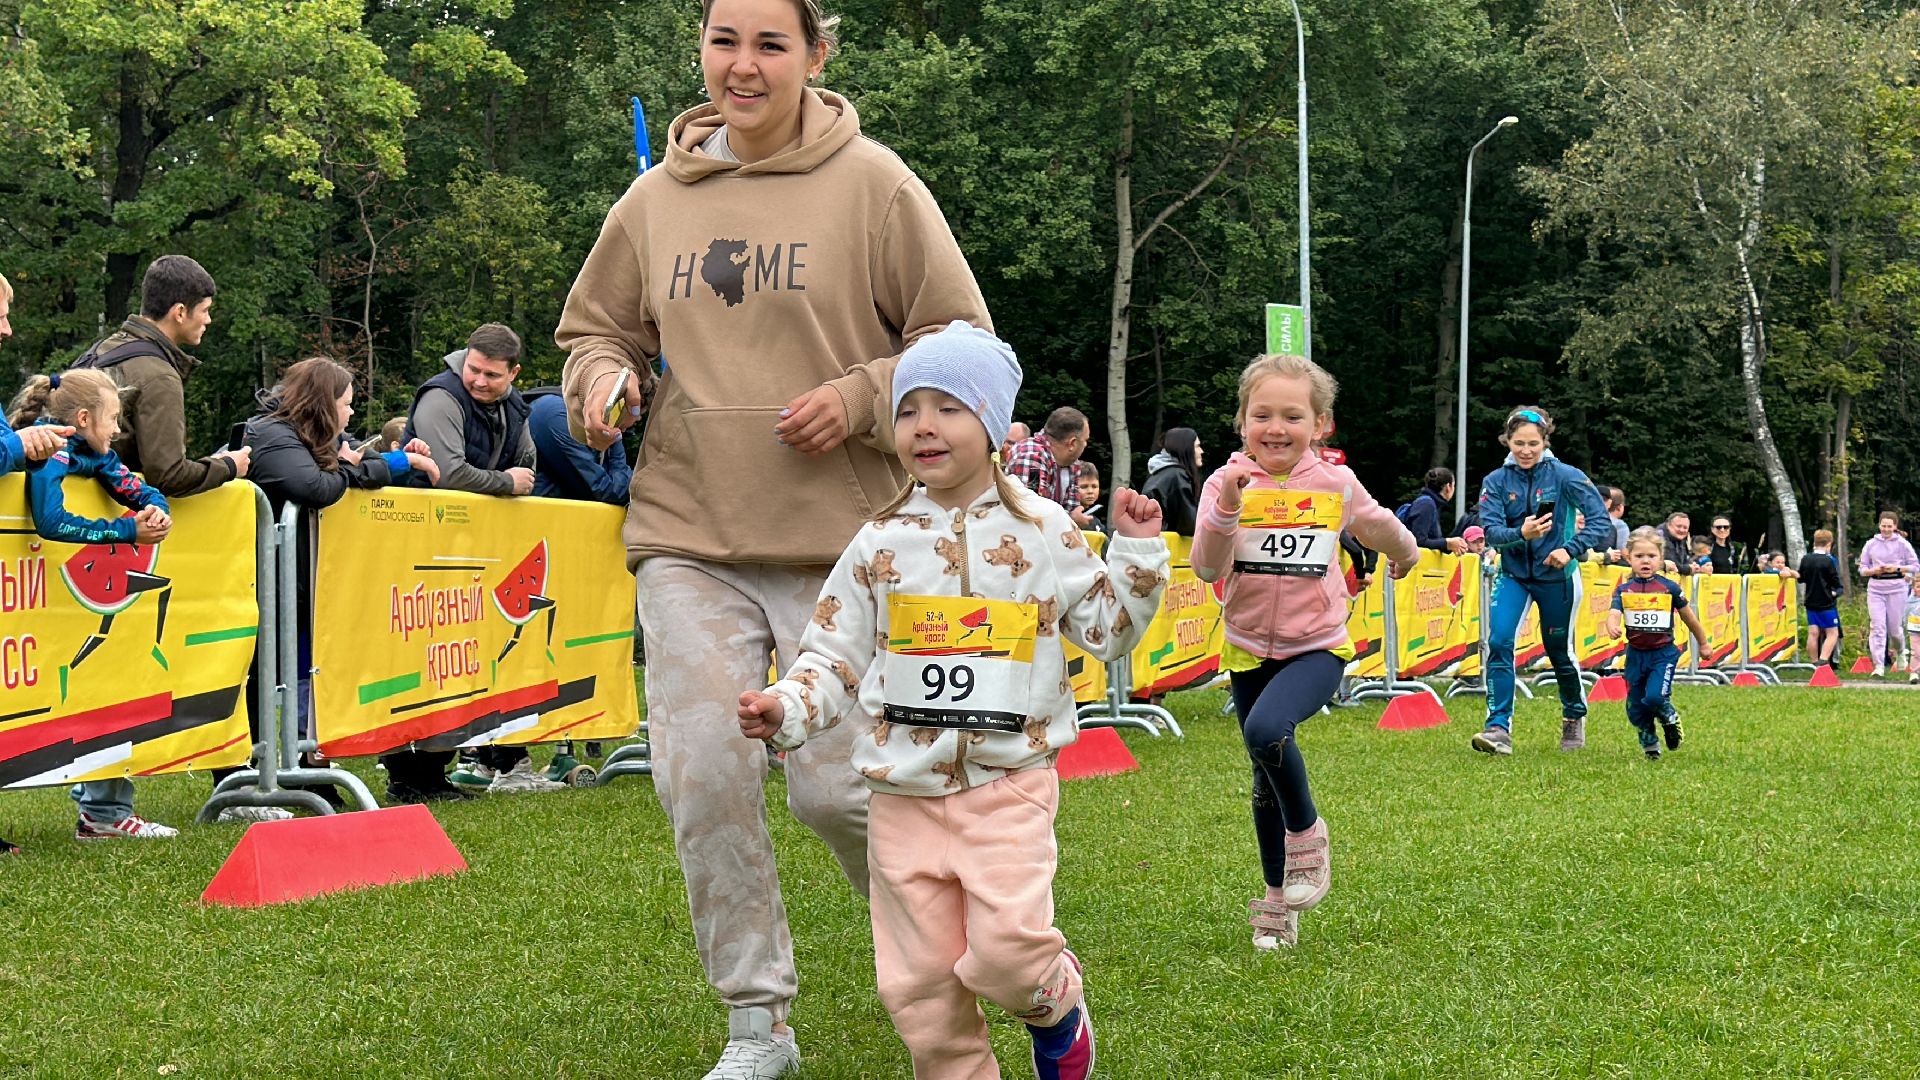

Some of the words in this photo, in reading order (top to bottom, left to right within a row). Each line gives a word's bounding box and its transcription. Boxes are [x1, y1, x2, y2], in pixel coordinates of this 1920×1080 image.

[1280, 313, 1292, 352] СИЛЫ
[372, 499, 395, 509] ПАРКИ
[372, 511, 425, 523] ПОДМОСКОВЬЯ
[1260, 534, 1316, 559] 497
[390, 573, 484, 642] Арбузный
[1634, 613, 1659, 625] 589
[427, 637, 480, 690] кросс
[921, 663, 975, 702] 99
